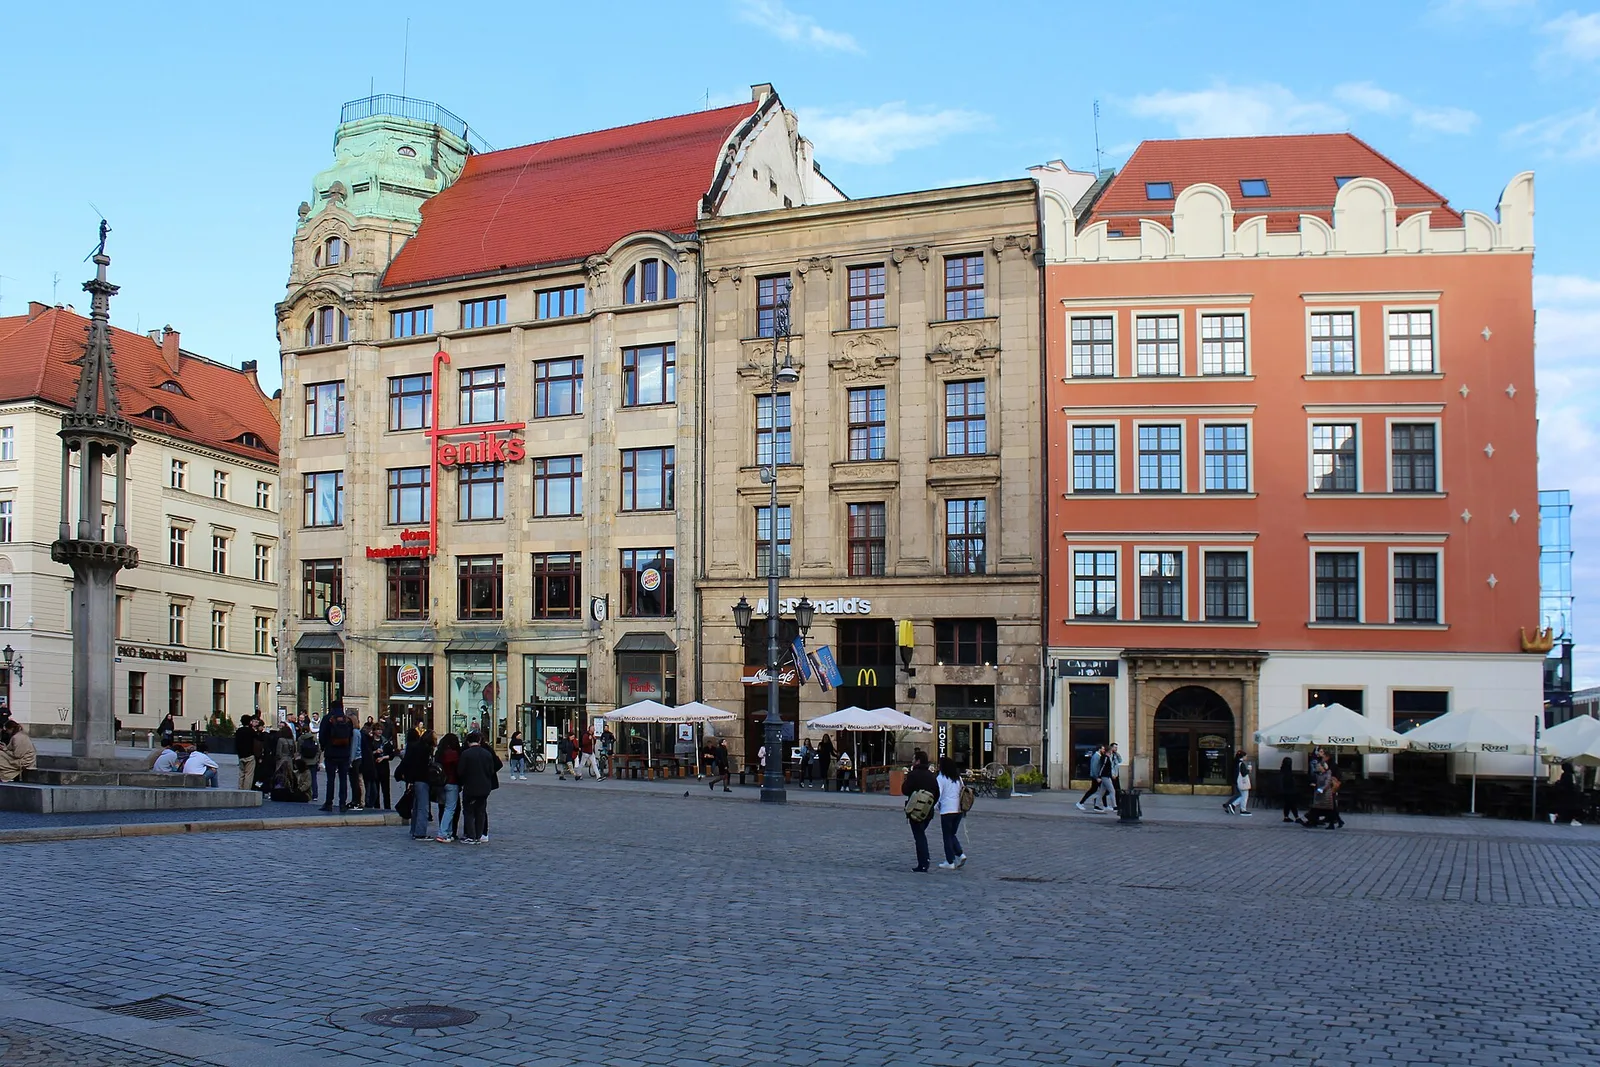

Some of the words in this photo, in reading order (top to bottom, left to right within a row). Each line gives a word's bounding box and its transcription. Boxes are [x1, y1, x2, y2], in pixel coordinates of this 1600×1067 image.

[400, 528, 430, 541] dom
[756, 597, 872, 614] McDnald's
[117, 646, 137, 658] PKO
[139, 648, 162, 660] Bank
[401, 669, 417, 677] BURGER
[401, 674, 418, 684] KING
[938, 726, 946, 759] HOSTE
[1279, 735, 1300, 743] Kozel
[1328, 736, 1355, 744] Kozel
[1380, 738, 1398, 747] Kozel
[1428, 742, 1452, 750] Kozel
[1481, 743, 1509, 752] Kozel
